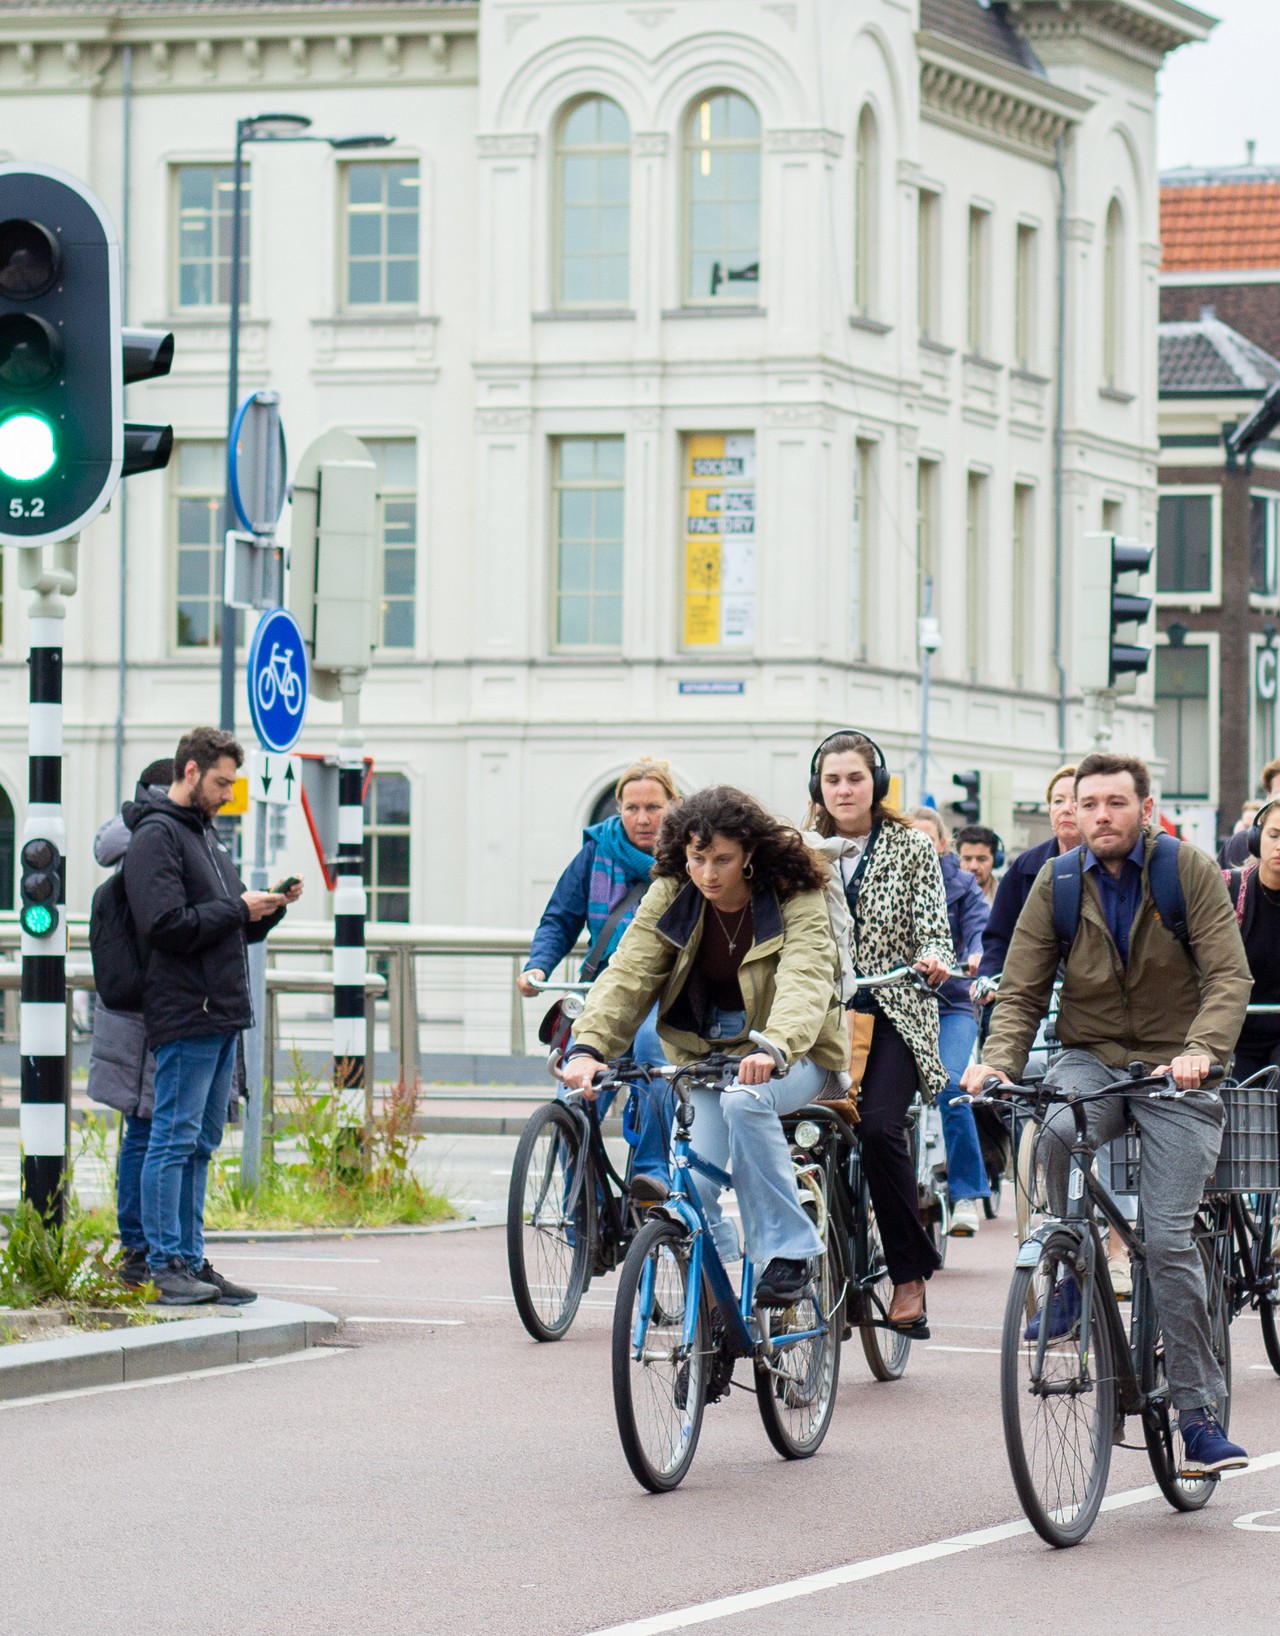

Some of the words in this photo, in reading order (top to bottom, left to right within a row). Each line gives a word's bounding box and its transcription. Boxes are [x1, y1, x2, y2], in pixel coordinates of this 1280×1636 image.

[693, 459, 742, 475] SOCIAL
[9, 498, 45, 518] 5.2
[689, 517, 753, 533] FACTORY
